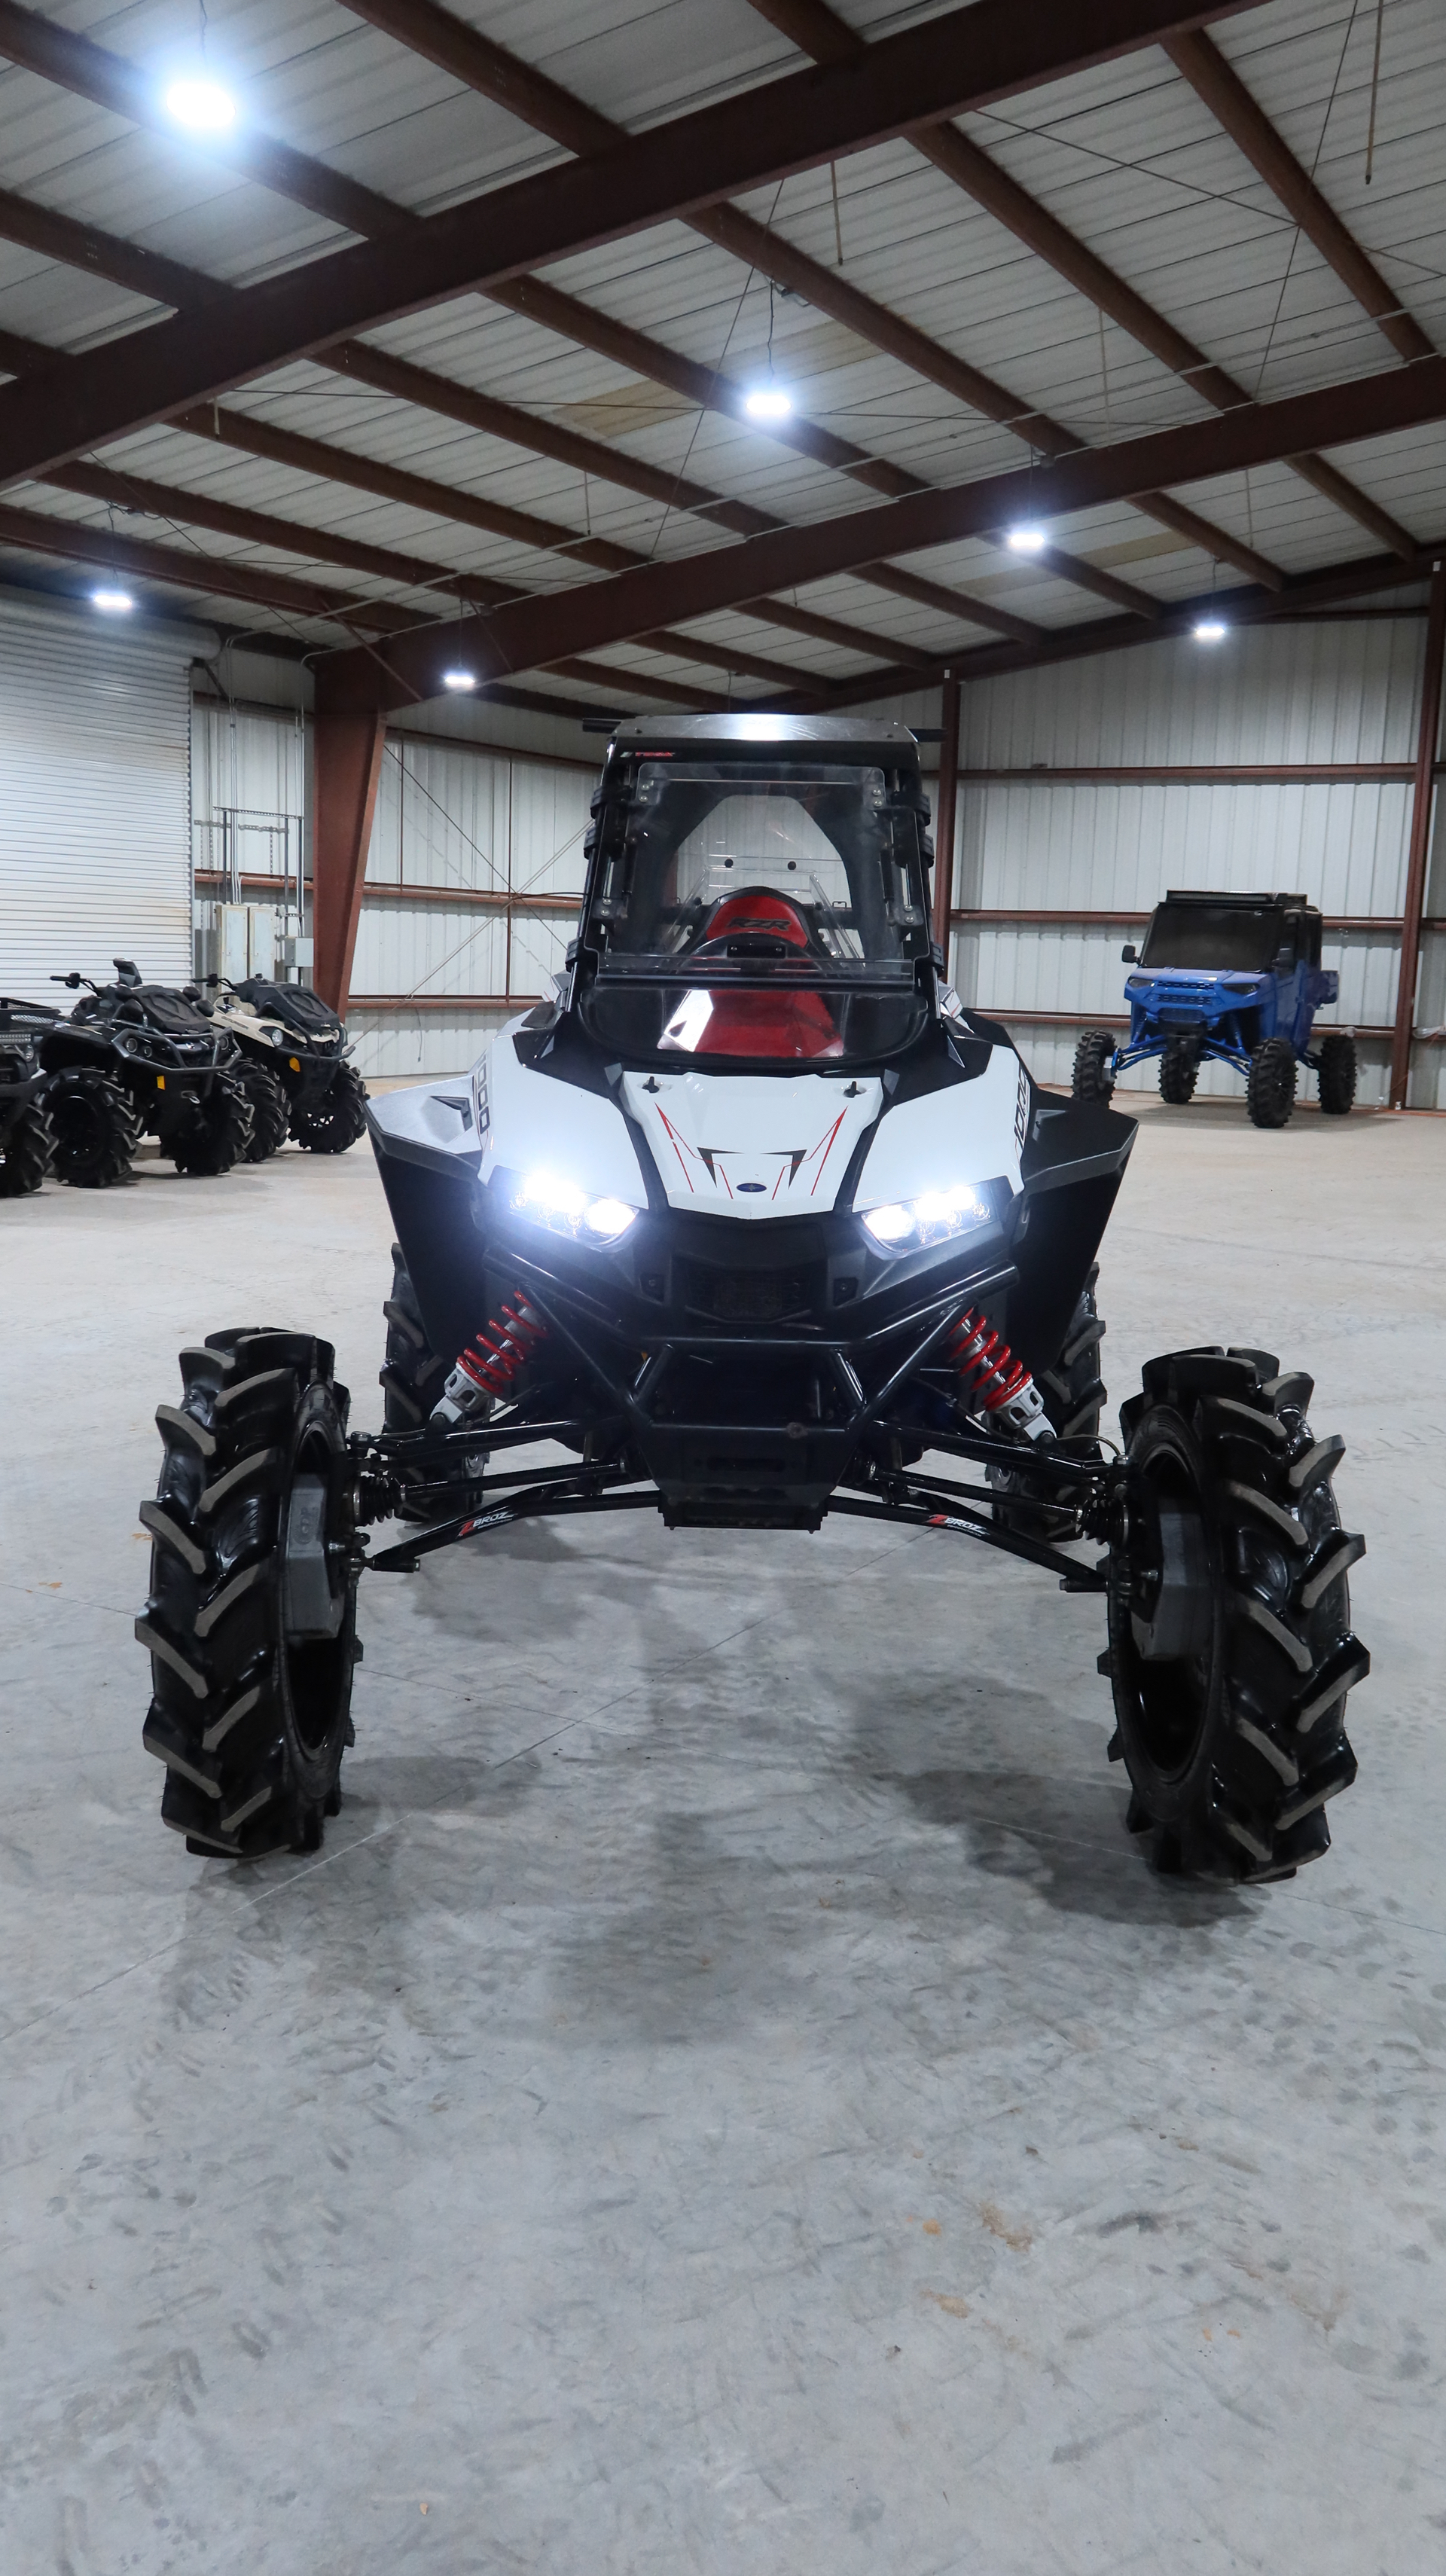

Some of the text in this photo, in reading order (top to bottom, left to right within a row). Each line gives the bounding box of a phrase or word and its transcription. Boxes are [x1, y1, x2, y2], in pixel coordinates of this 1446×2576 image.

[725, 917, 791, 931] RZR
[477, 1054, 490, 1134] 1000
[458, 1511, 515, 1537] ZBROZ
[929, 1513, 987, 1534] ZBROZ
